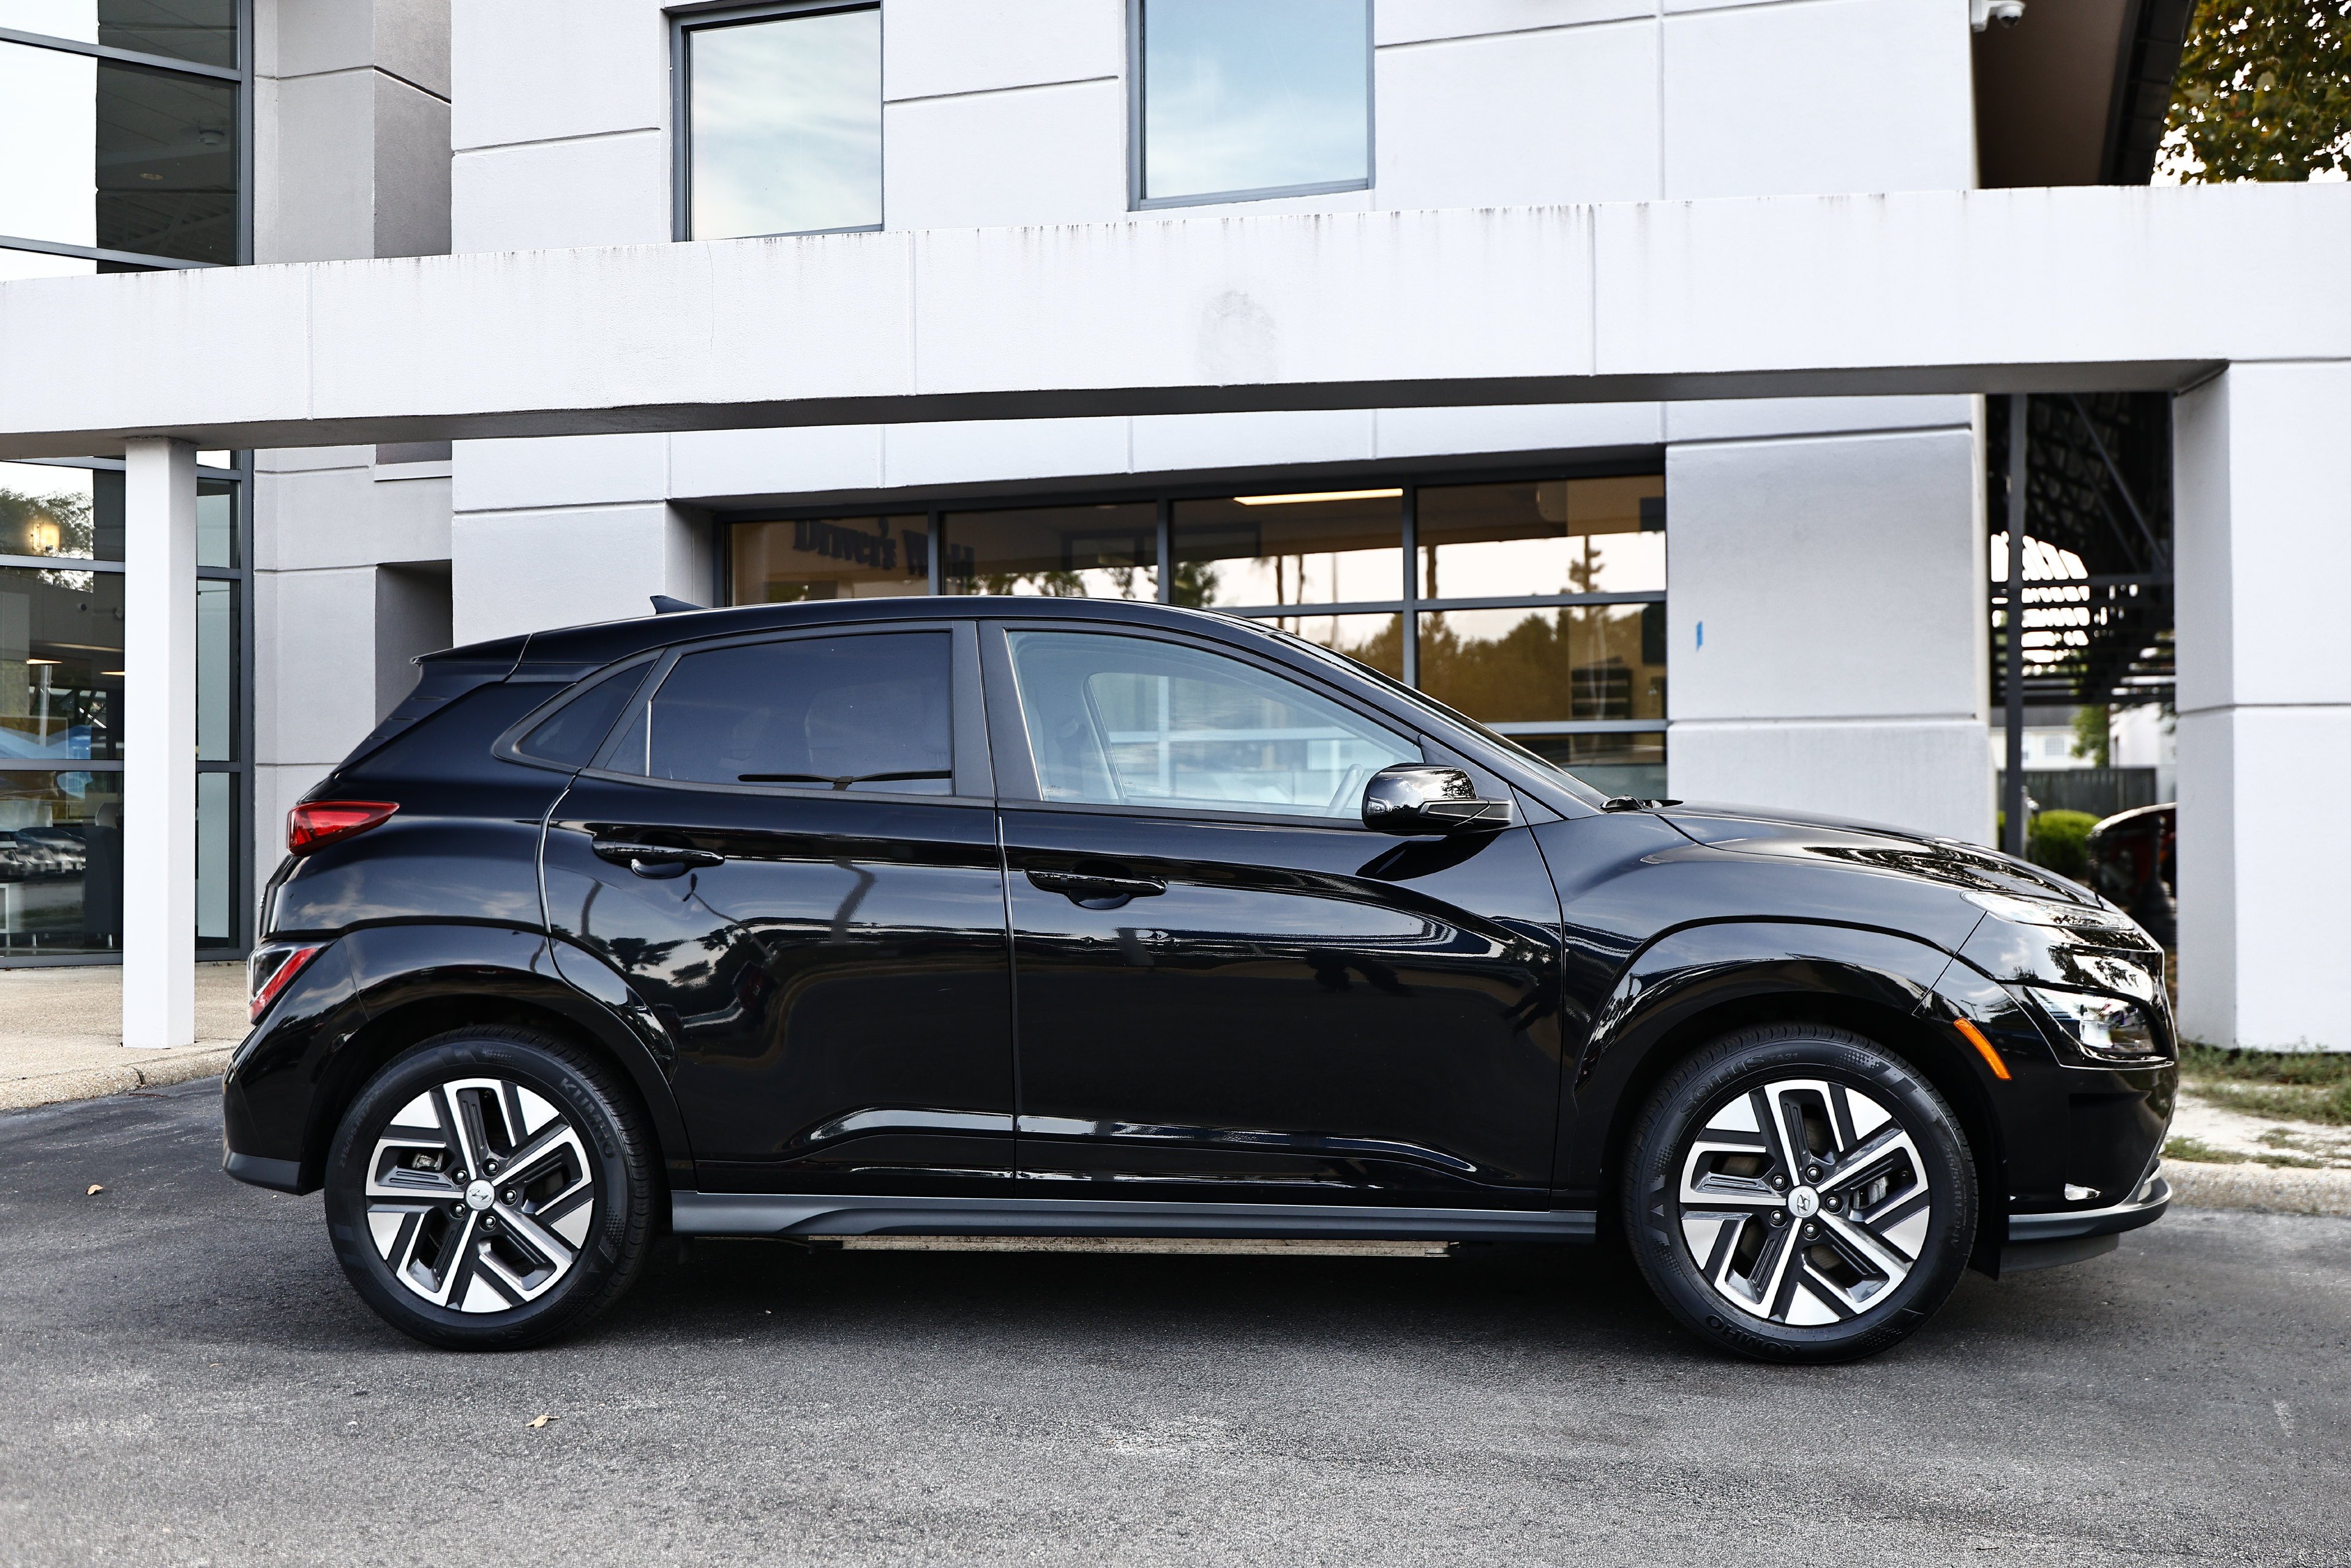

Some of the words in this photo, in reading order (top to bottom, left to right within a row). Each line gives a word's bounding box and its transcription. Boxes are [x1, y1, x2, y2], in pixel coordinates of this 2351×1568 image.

[1679, 1053, 1764, 1116] SOLUS
[1768, 1051, 1799, 1063] TA31
[558, 1077, 618, 1159] KUMHO
[1941, 1142, 1961, 1188] 215/55
[1704, 1312, 1801, 1357] KUMHO
